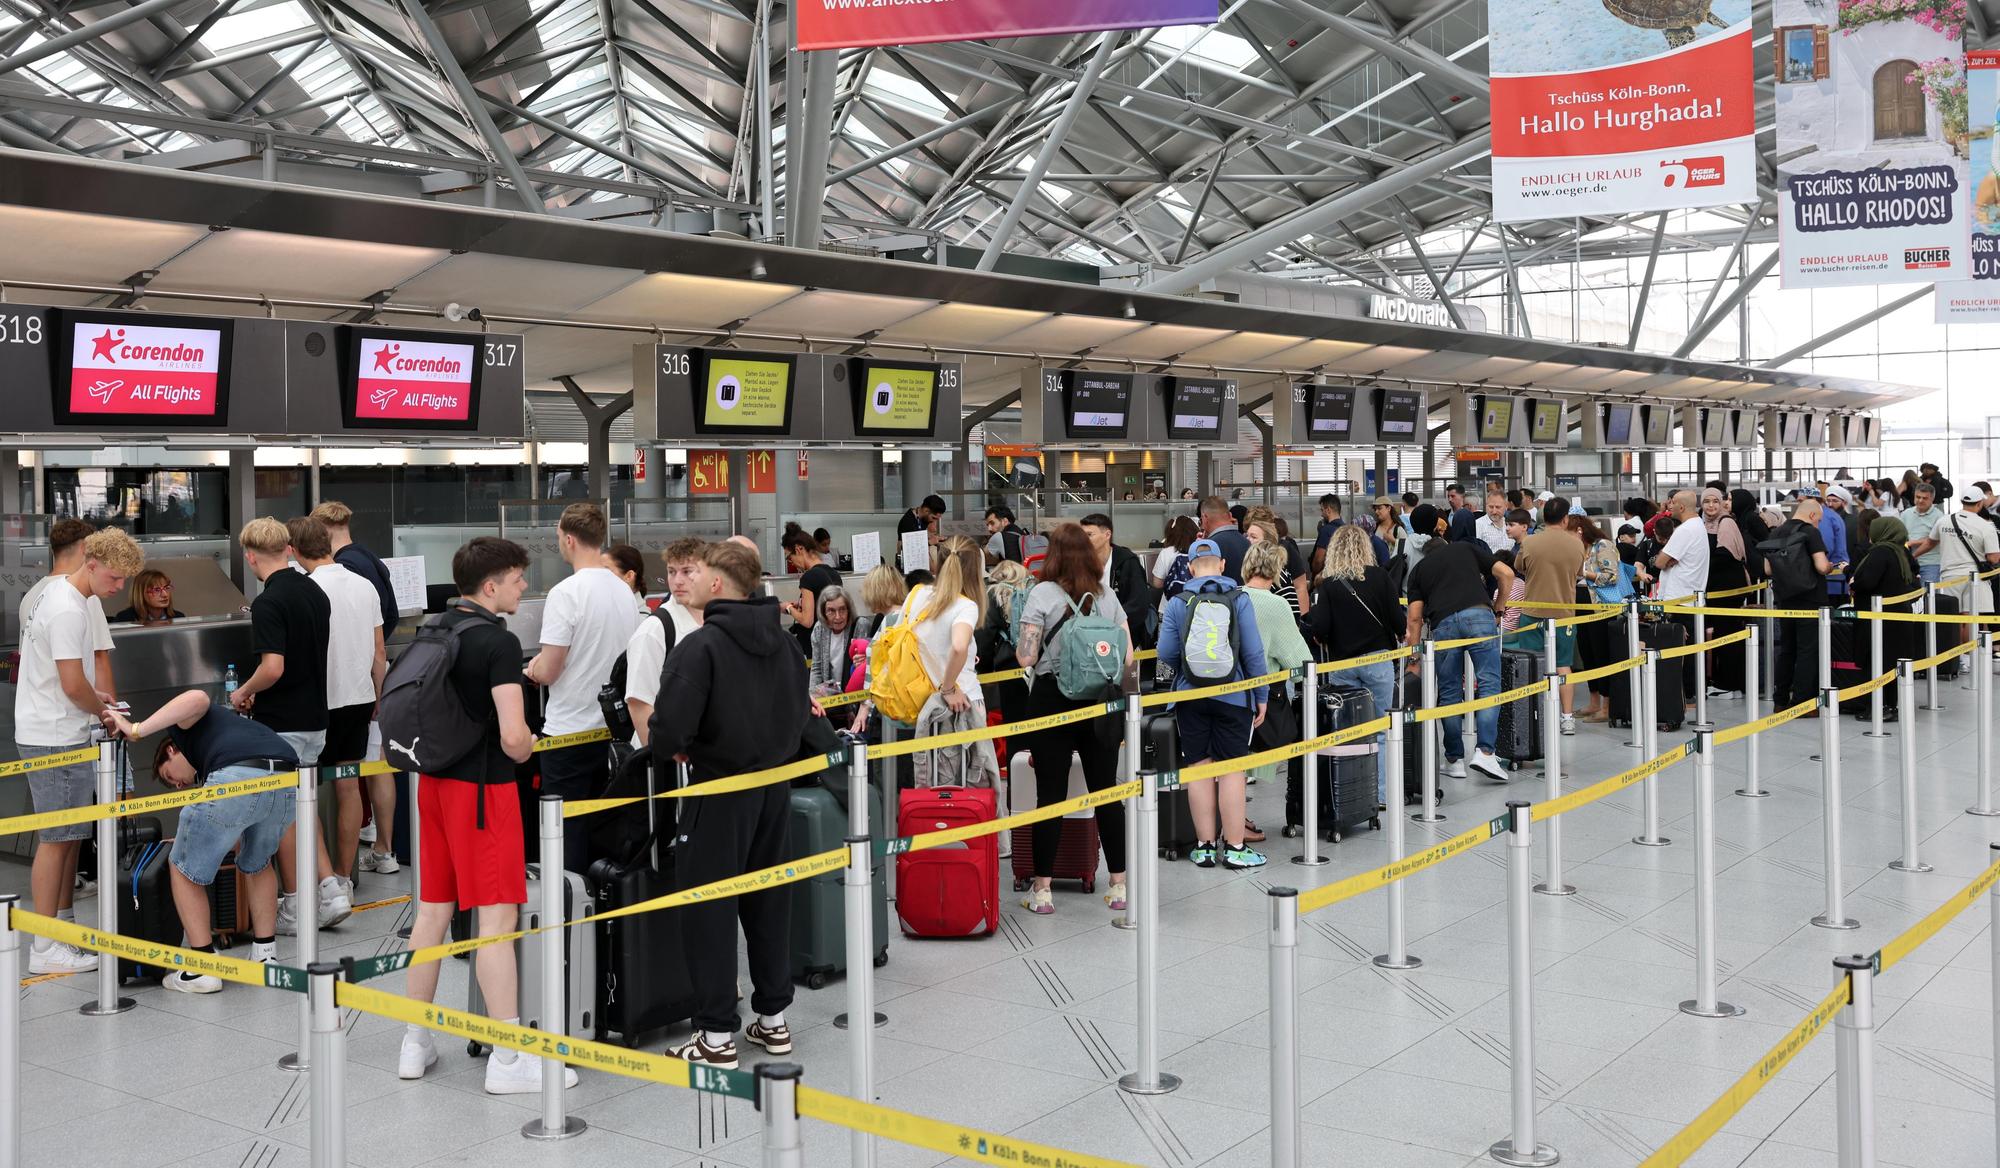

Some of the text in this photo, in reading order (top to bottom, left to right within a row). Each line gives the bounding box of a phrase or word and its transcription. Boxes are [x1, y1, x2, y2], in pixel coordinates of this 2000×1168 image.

[1548, 82, 1691, 106] Tschüss Köln-Bonn.
[1520, 97, 1722, 135] Hallo Hurghada!
[1521, 167, 1642, 187] ENDLICH URLAUB
[1691, 173, 1721, 181] TOURS
[1794, 171, 1952, 197] TSCHÜSS KÖLN-BONN.
[1521, 183, 1608, 198] www.oeger.de
[1801, 195, 1946, 226] HALLO RHODOS!
[1800, 253, 1889, 266] ENDLICH URLAUB
[1904, 249, 1950, 263] BUCHER
[1800, 263, 1889, 274] www.bucher-reisen.de
[121, 343, 204, 362] corendon
[485, 343, 516, 367] 317
[158, 361, 203, 369] AIRLINES
[396, 356, 461, 373] corendon
[662, 354, 690, 375] 316
[938, 369, 957, 388] 315
[1046, 375, 1063, 392] 314
[130, 385, 201, 403] All Flights
[1224, 384, 1236, 400] 13
[1294, 388, 1306, 404] 312
[402, 393, 458, 410] All Flights
[702, 455, 714, 466] WC
[48, 757, 60, 765] Bonn
[62, 753, 82, 762] Airport
[229, 779, 281, 793] Köln Bonn Airport
[129, 795, 186, 810] Köln Bonn Airport
[98, 937, 146, 956] Köln Bonn Airport
[185, 956, 239, 975] Köln Bonn Airport
[447, 1015, 516, 1042] Köln Bonn Airport
[573, 1046, 651, 1072] Köln Bonn Airport
[992, 1143, 1018, 1160] Köln
[1023, 1150, 1051, 1167] Bonn
